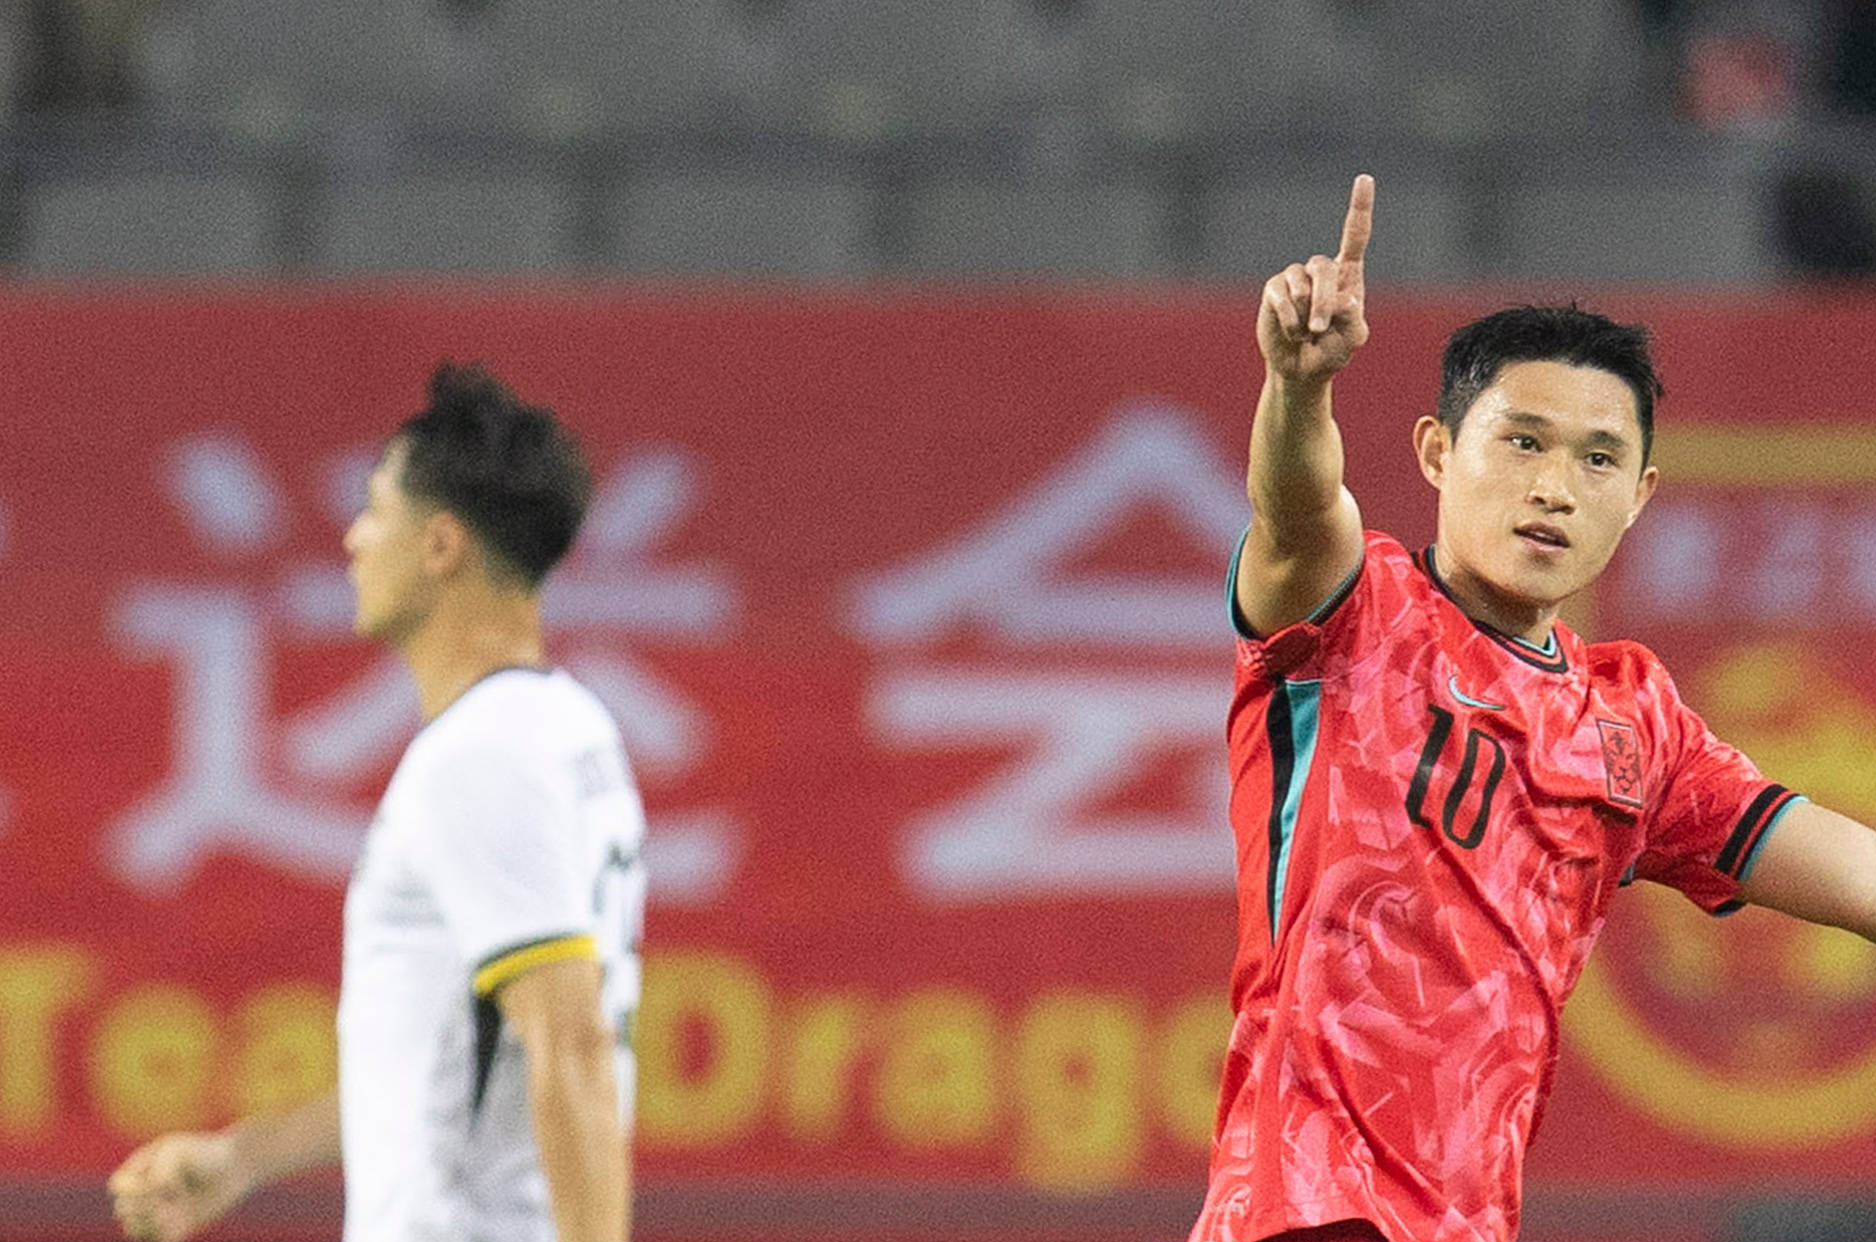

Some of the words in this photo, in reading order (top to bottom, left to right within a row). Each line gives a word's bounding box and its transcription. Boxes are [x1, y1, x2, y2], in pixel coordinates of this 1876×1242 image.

[0, 402, 1246, 898] 迷会
[1405, 703, 1505, 850] 10
[0, 948, 340, 1135] Tea
[635, 955, 1236, 1192] Drago
